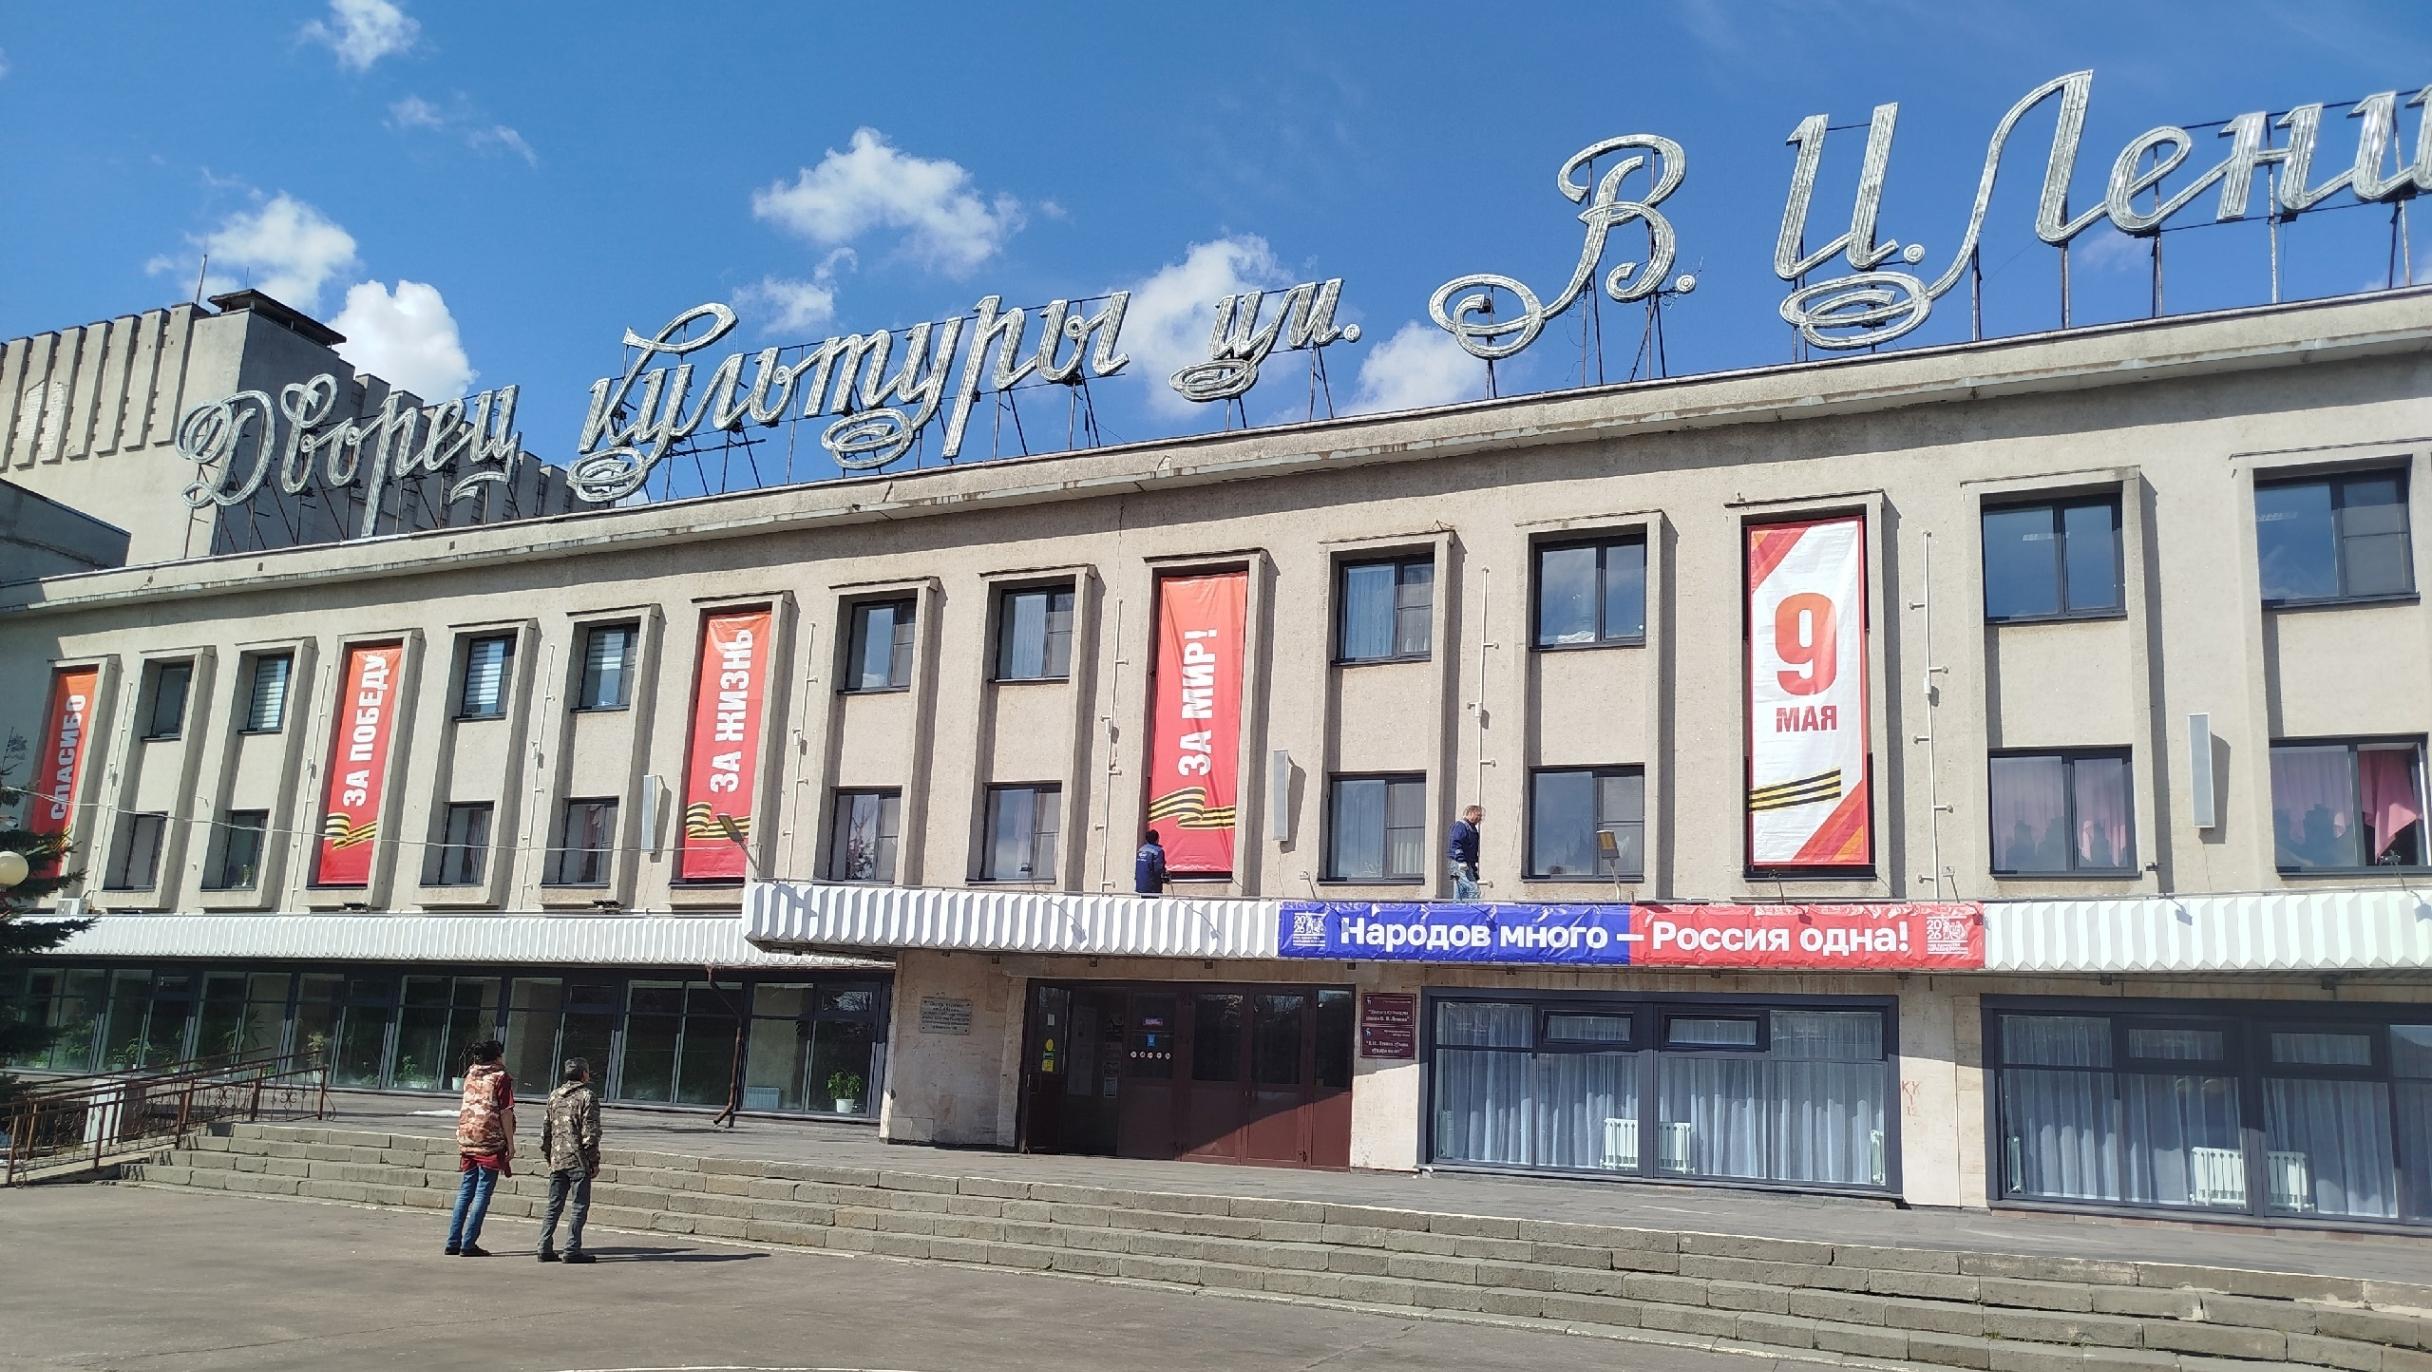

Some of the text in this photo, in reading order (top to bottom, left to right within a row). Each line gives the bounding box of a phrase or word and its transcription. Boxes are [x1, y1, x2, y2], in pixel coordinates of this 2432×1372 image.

[176, 373, 521, 538] Дворец
[1168, 277, 1362, 401] им.
[1428, 133, 1696, 360] В.
[1774, 592, 1837, 696] 9
[50, 694, 86, 821] СПАСИБО
[343, 654, 390, 807] ЗА ПОБЕДУ
[709, 628, 754, 793] ЗА ЖИЗНЬ
[1177, 629, 1217, 776] ЗА МИР!
[1776, 704, 1837, 733] МАЯ
[1341, 917, 1492, 952] Народов
[1501, 926, 1608, 949] много
[1652, 921, 1791, 952] Россия
[1800, 921, 1909, 956] одна!
[1926, 919, 1943, 930] 20
[1926, 929, 1943, 940] 26
